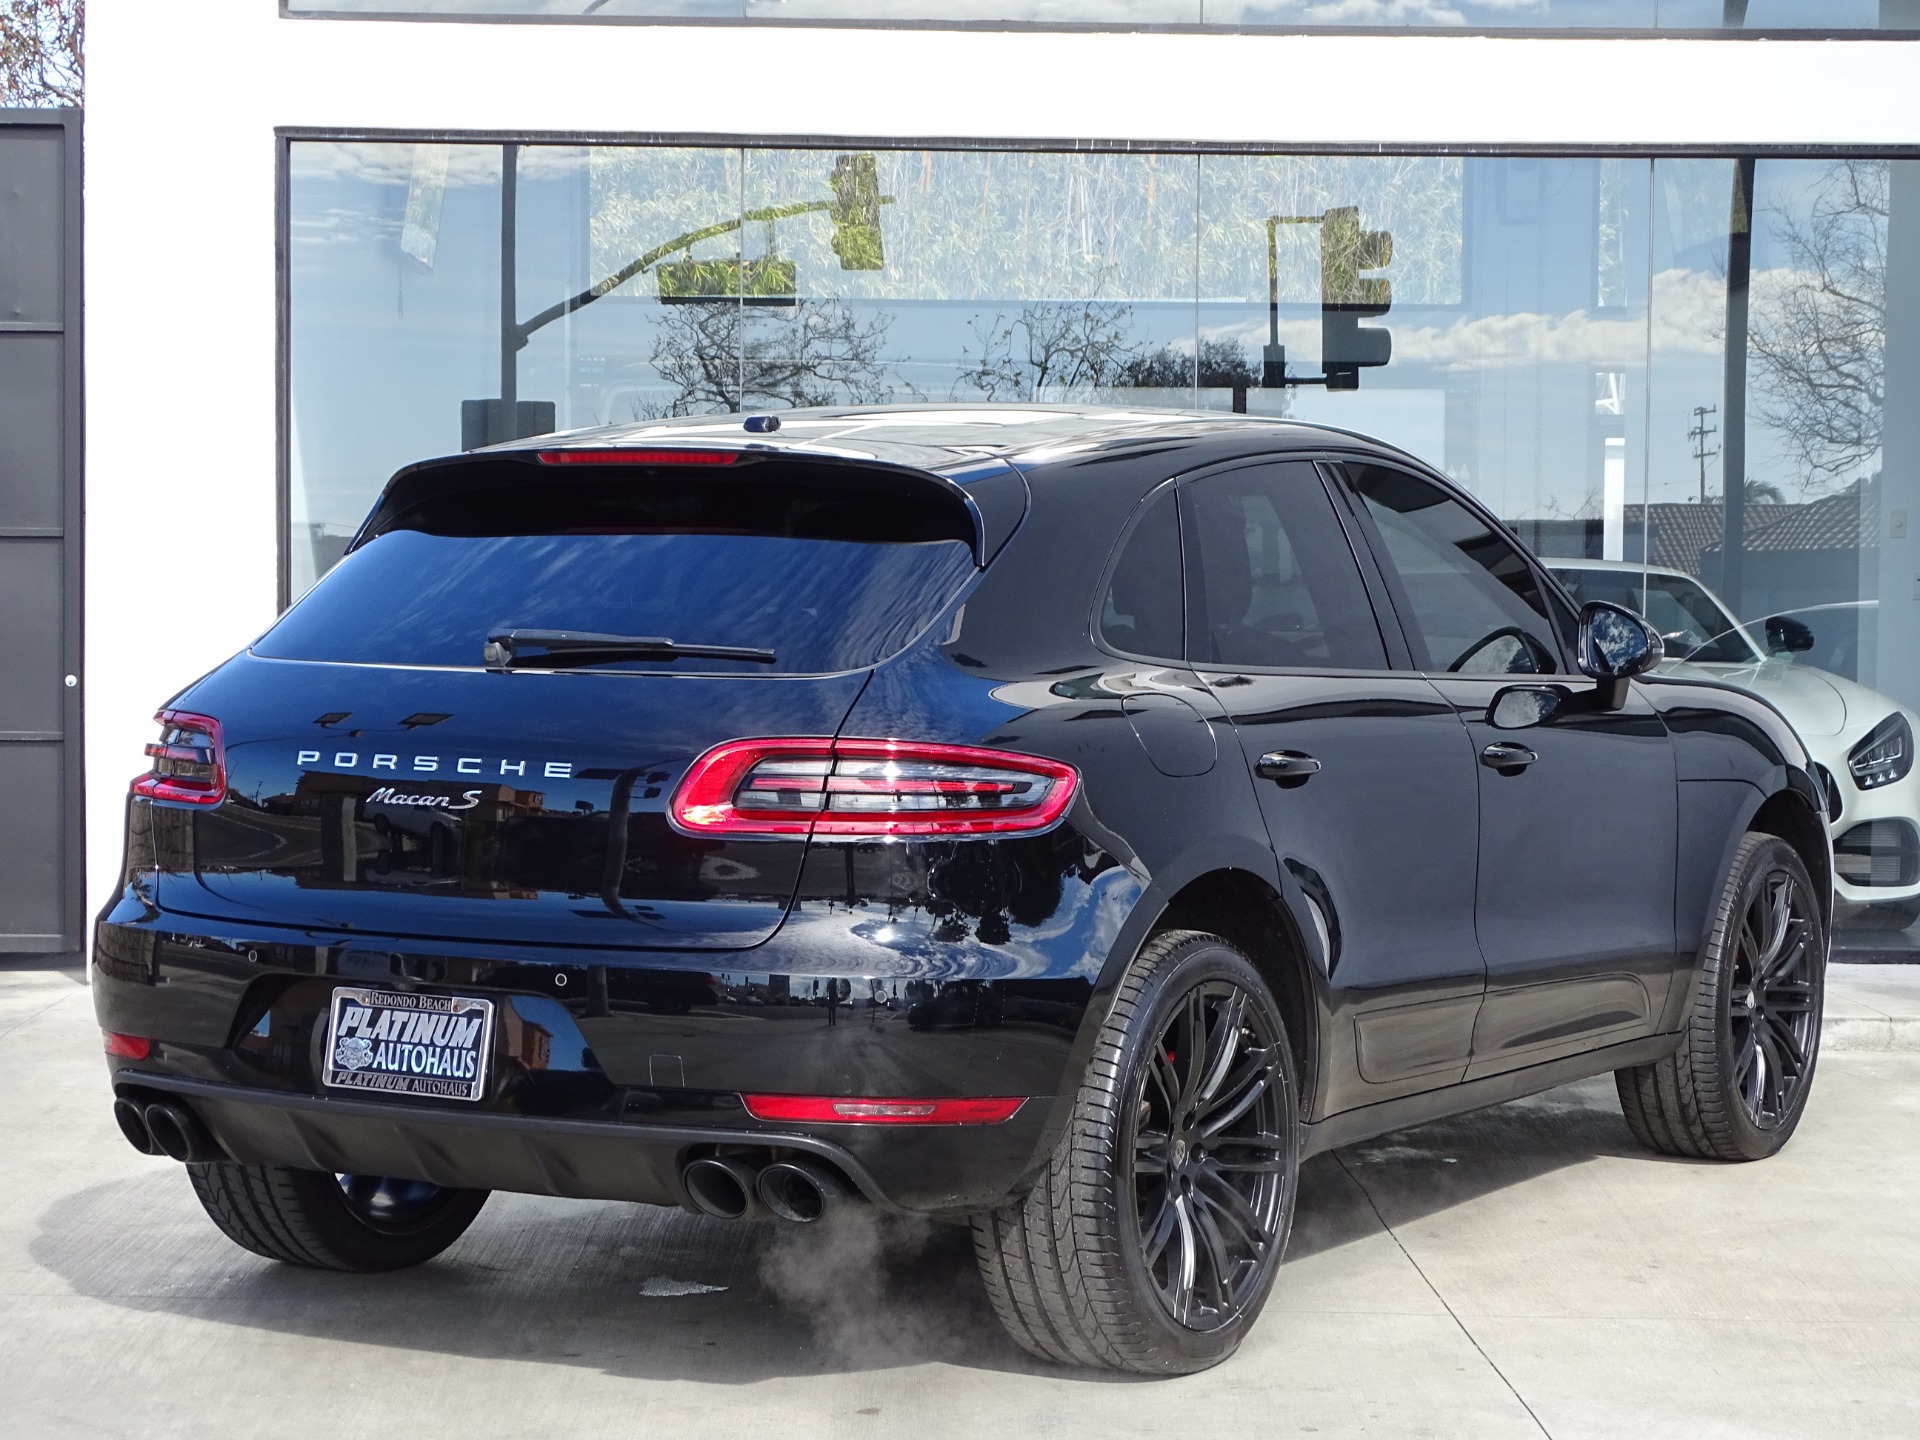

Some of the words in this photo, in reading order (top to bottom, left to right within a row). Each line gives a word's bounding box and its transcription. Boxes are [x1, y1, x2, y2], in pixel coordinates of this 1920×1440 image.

[297, 750, 572, 778] PORSCHE
[366, 787, 449, 807] Macan
[448, 790, 482, 809] S
[370, 992, 417, 1008] REDONDO
[418, 996, 451, 1011] BEACH
[337, 1006, 482, 1048] PLATINUM
[372, 1042, 476, 1078] AUTOHAUS
[335, 1072, 411, 1091] PLATINUM
[412, 1079, 467, 1097] AUTOHAUS
